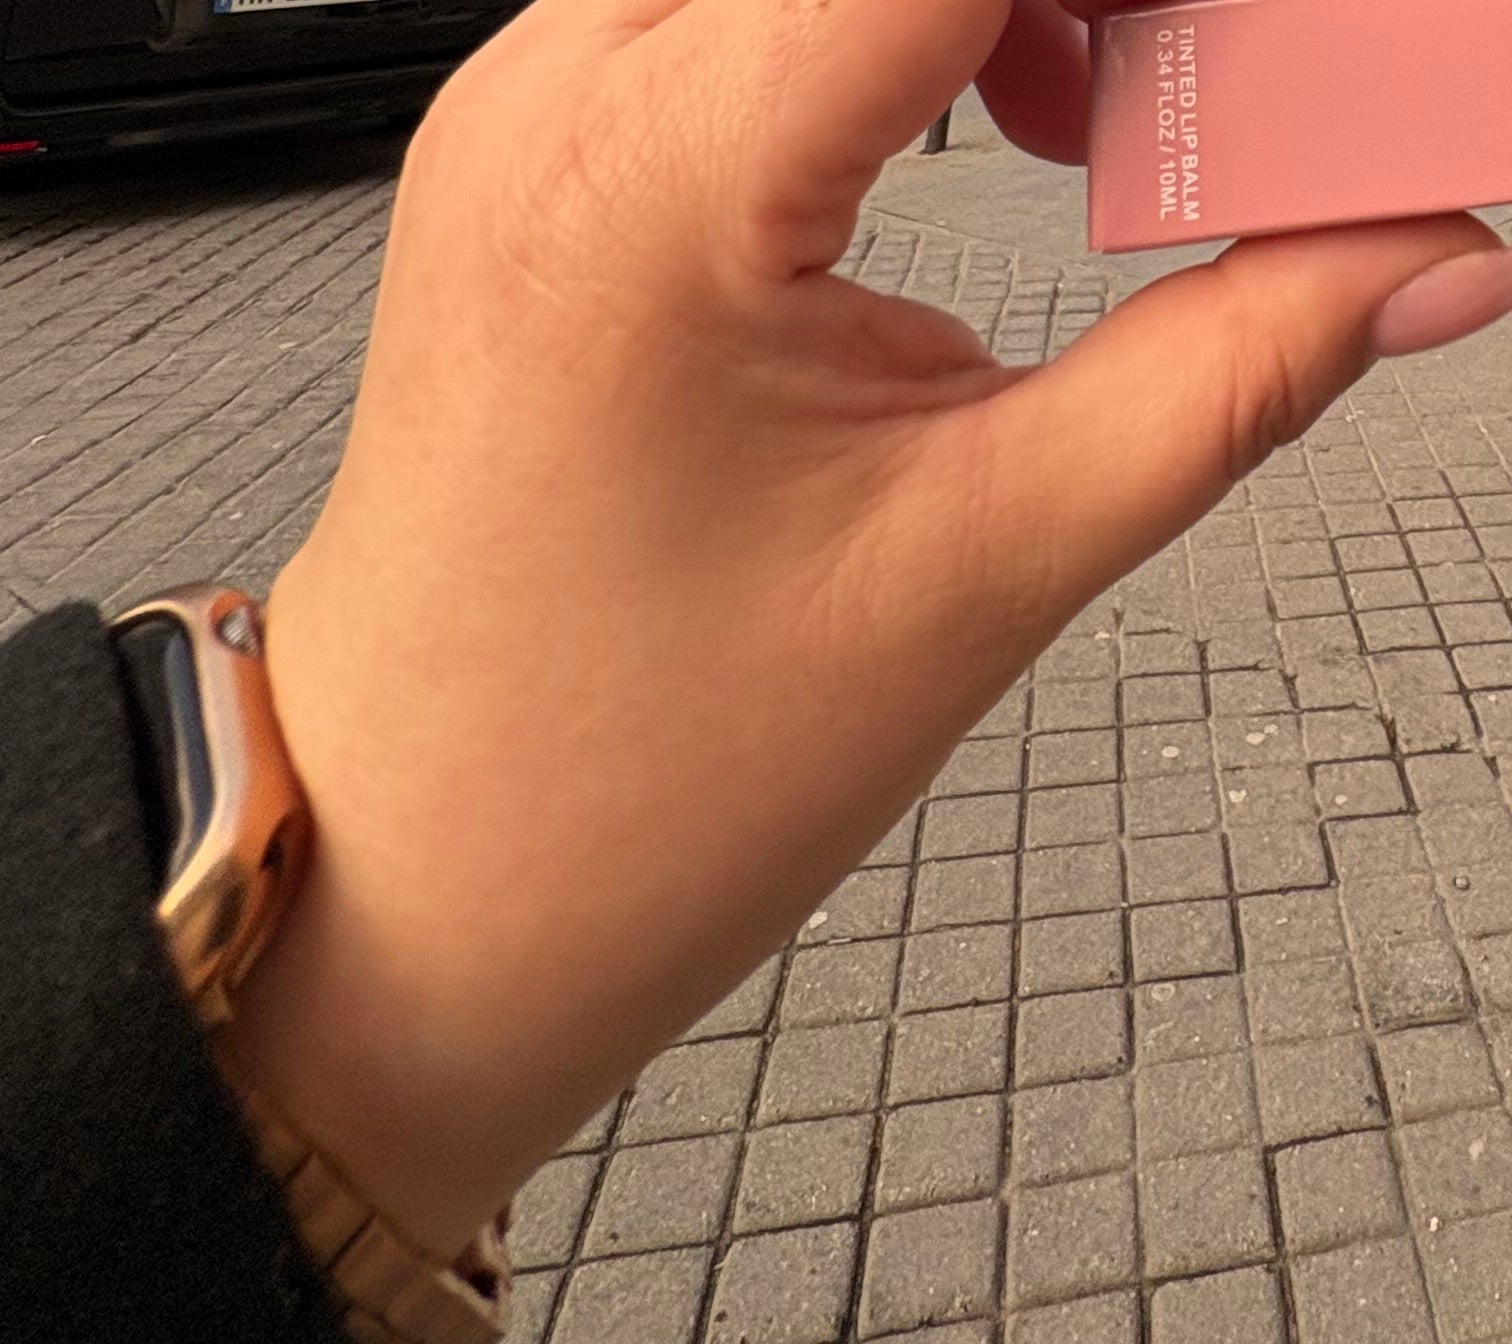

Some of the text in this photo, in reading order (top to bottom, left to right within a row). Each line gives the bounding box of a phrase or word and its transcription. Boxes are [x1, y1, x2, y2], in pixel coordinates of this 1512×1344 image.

[1157, 30, 1174, 75] 0.34
[1159, 145, 1176, 153] /
[1178, 24, 1200, 221] TINTED LIP BALM
[1159, 160, 1177, 221] 10ML
